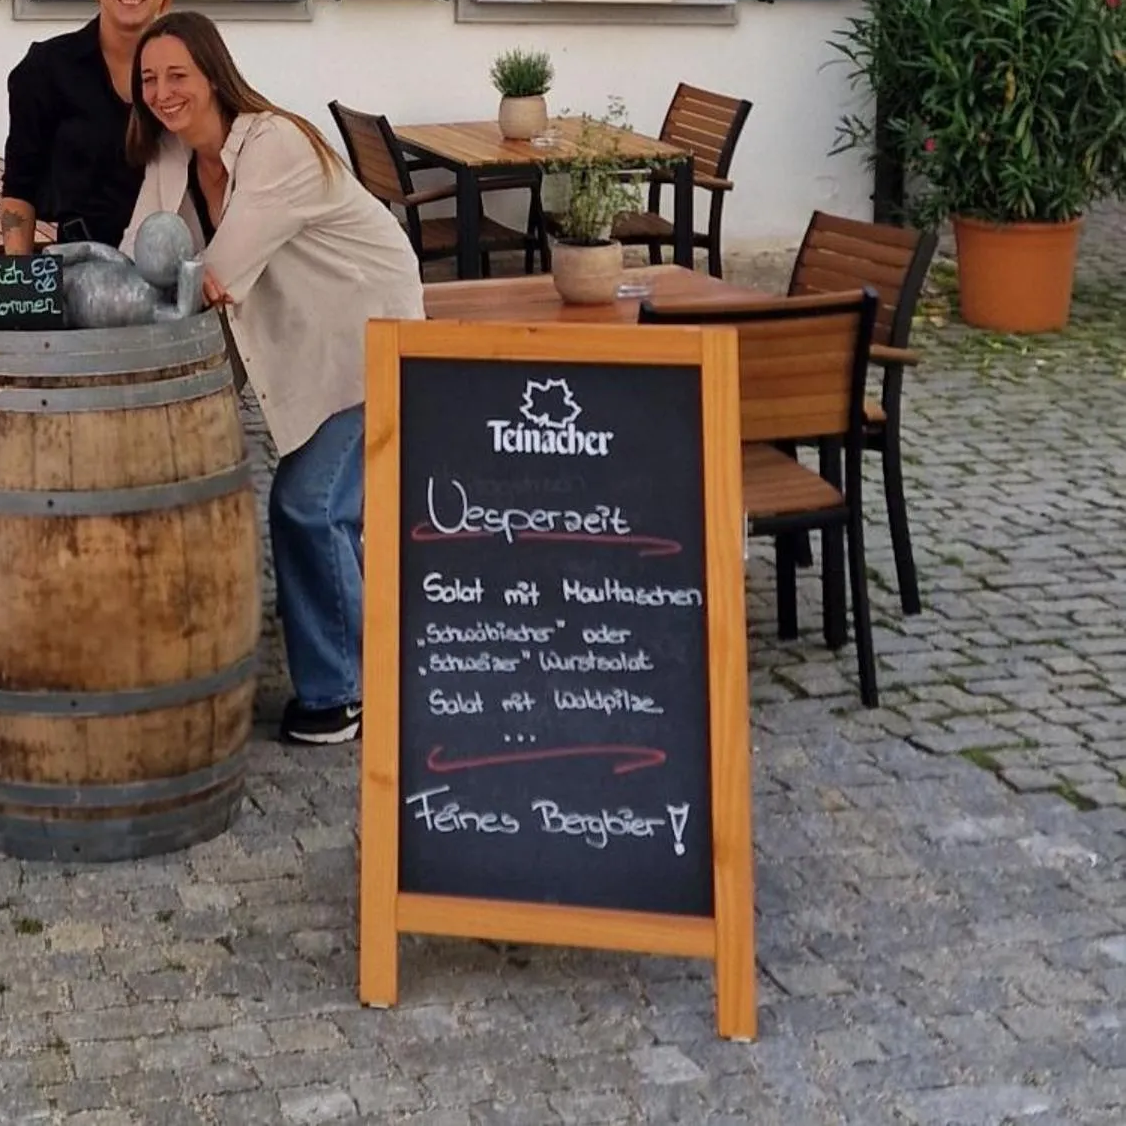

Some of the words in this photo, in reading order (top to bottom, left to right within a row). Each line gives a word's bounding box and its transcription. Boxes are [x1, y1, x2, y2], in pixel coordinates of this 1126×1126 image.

[486, 420, 615, 456] Teinacher
[427, 476, 632, 543] Vesperzeit
[423, 572, 484, 604] Salat
[504, 581, 541, 606] mit
[563, 577, 702, 606] Maultaschen
[582, 623, 632, 645] oder
[539, 649, 654, 672] Wurstsalat
[428, 688, 484, 715] Salat
[501, 692, 536, 712] mit
[406, 784, 520, 834] Feines
